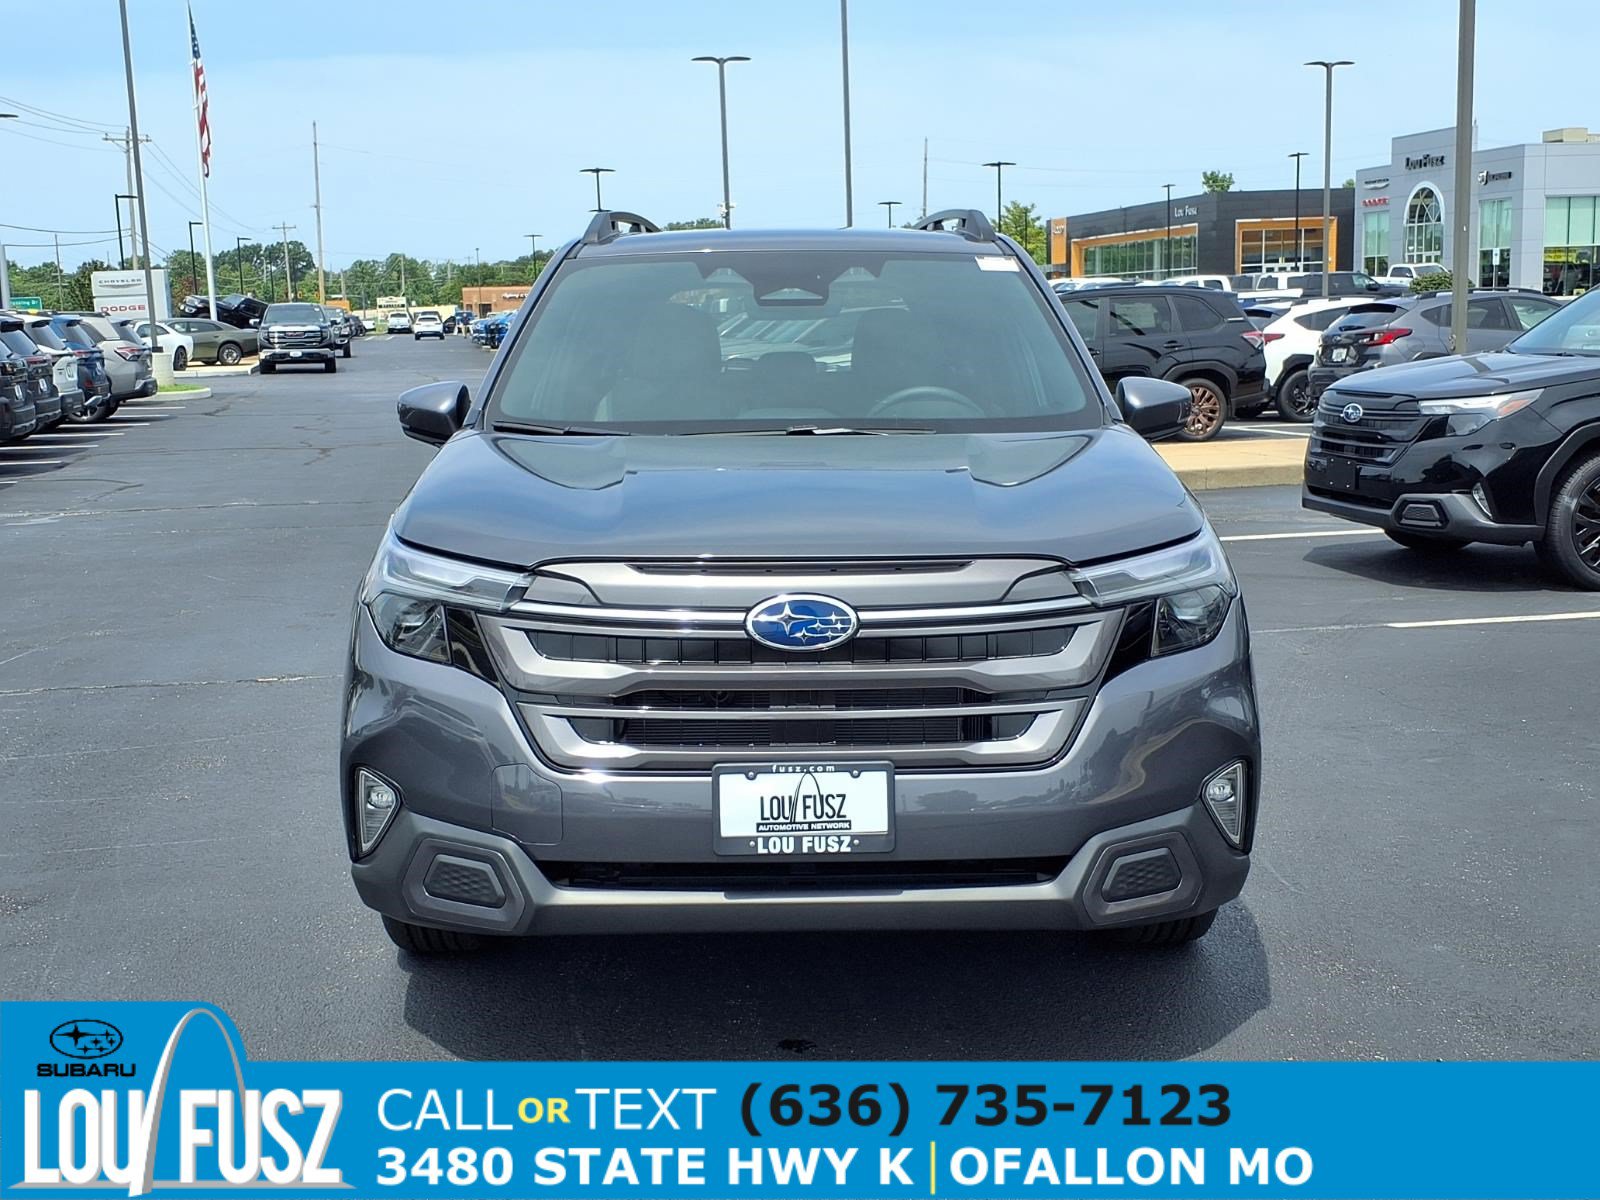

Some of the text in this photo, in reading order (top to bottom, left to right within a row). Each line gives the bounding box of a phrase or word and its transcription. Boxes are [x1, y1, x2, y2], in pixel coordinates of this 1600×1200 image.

[101, 304, 146, 312] DODGE
[772, 764, 835, 773] fusz.com
[760, 794, 847, 821] LOU FUSZ
[758, 821, 850, 832] AUTOMOTIVE NETWORK
[757, 835, 852, 854] LOU FUSZ
